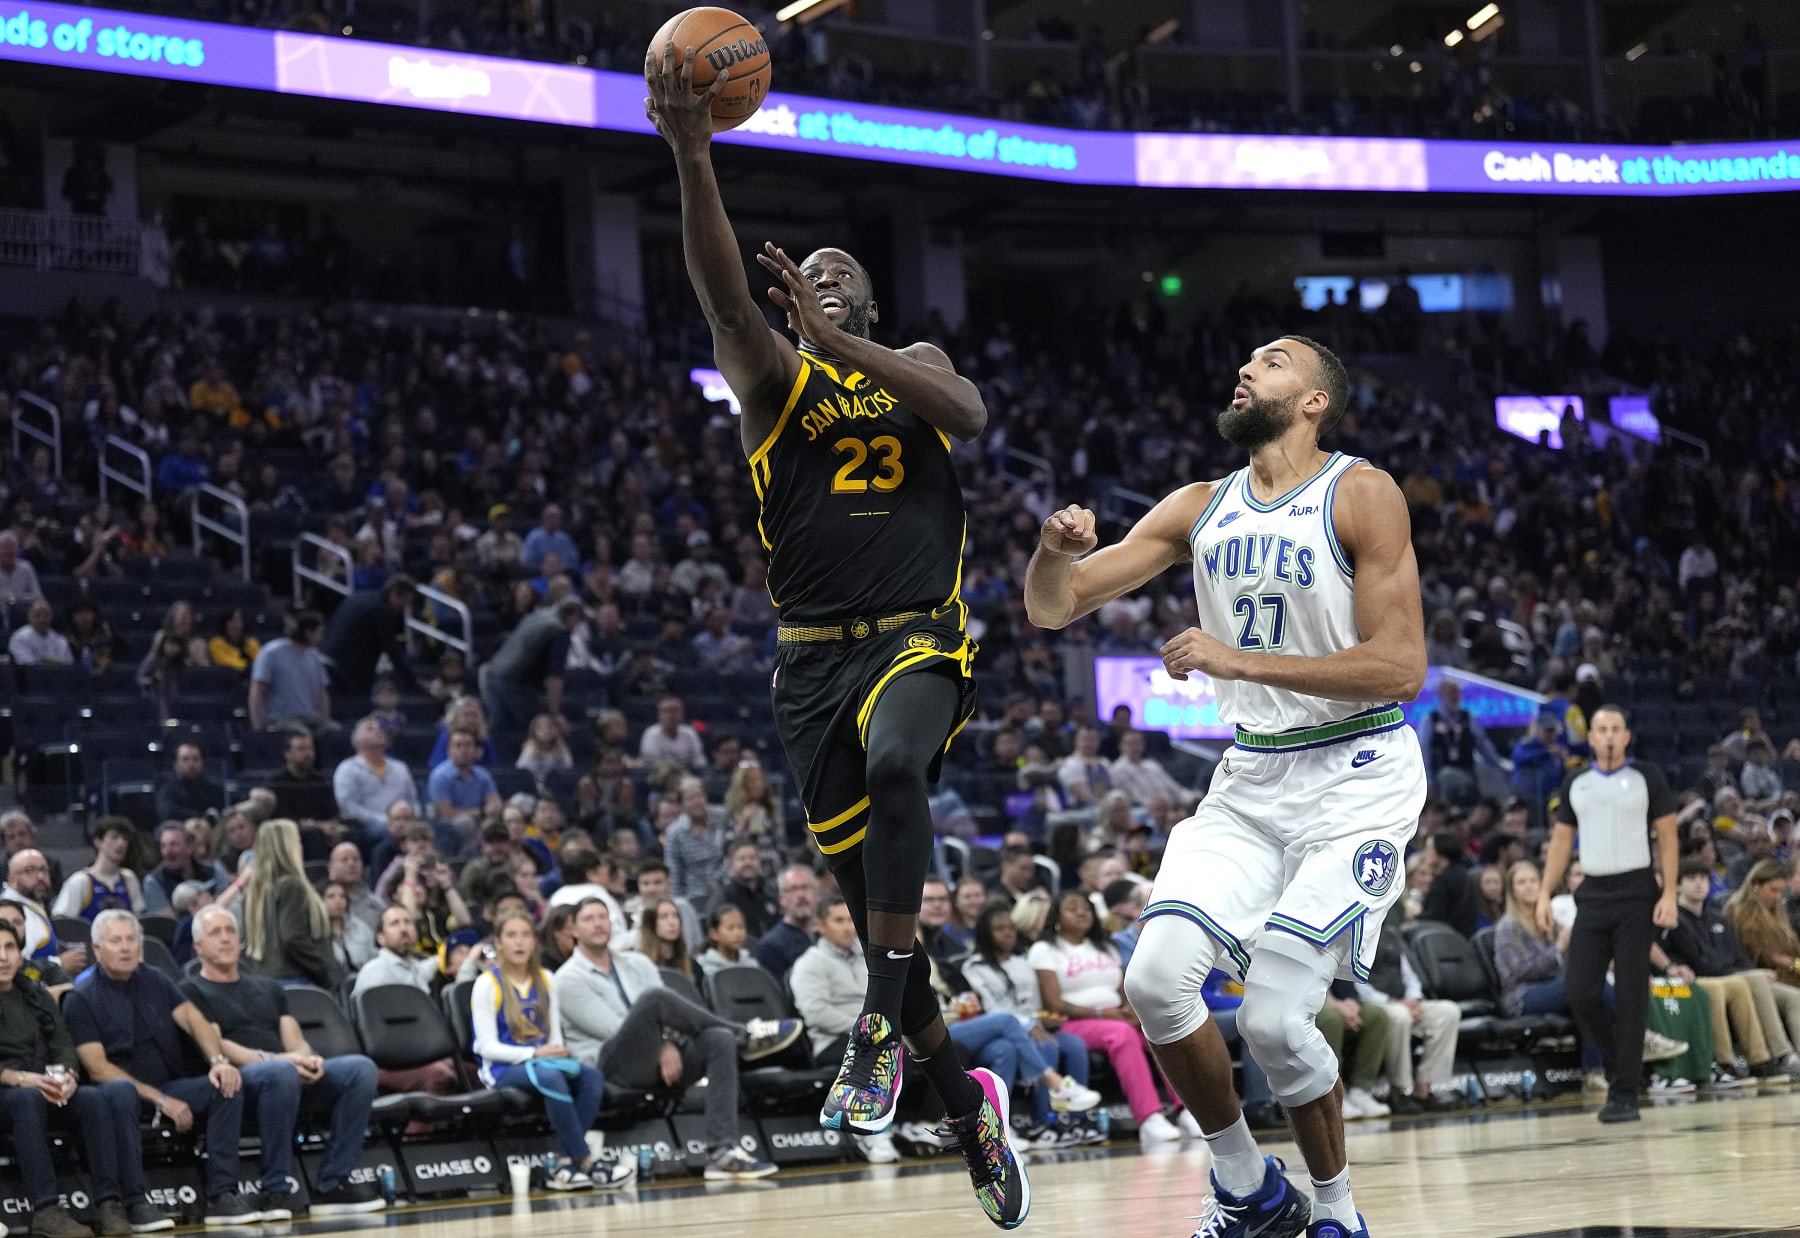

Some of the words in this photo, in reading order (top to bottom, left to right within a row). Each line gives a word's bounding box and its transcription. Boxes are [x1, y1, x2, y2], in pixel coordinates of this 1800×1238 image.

[52, 18, 93, 53] of
[97, 25, 205, 67] stores
[704, 38, 769, 72] Wilson
[799, 110, 830, 141] at
[830, 112, 967, 158] thousands
[967, 128, 998, 160] of
[998, 134, 1078, 170] stores
[1484, 151, 1550, 182] Cash
[1553, 153, 1620, 184] Back
[1621, 156, 1651, 184] at
[801, 398, 841, 441] SAN
[831, 435, 905, 494] 23
[1202, 532, 1315, 591] WOLVES
[1233, 593, 1287, 650] 27
[772, 1131, 825, 1148] CHASE
[415, 1158, 474, 1180] CHASE
